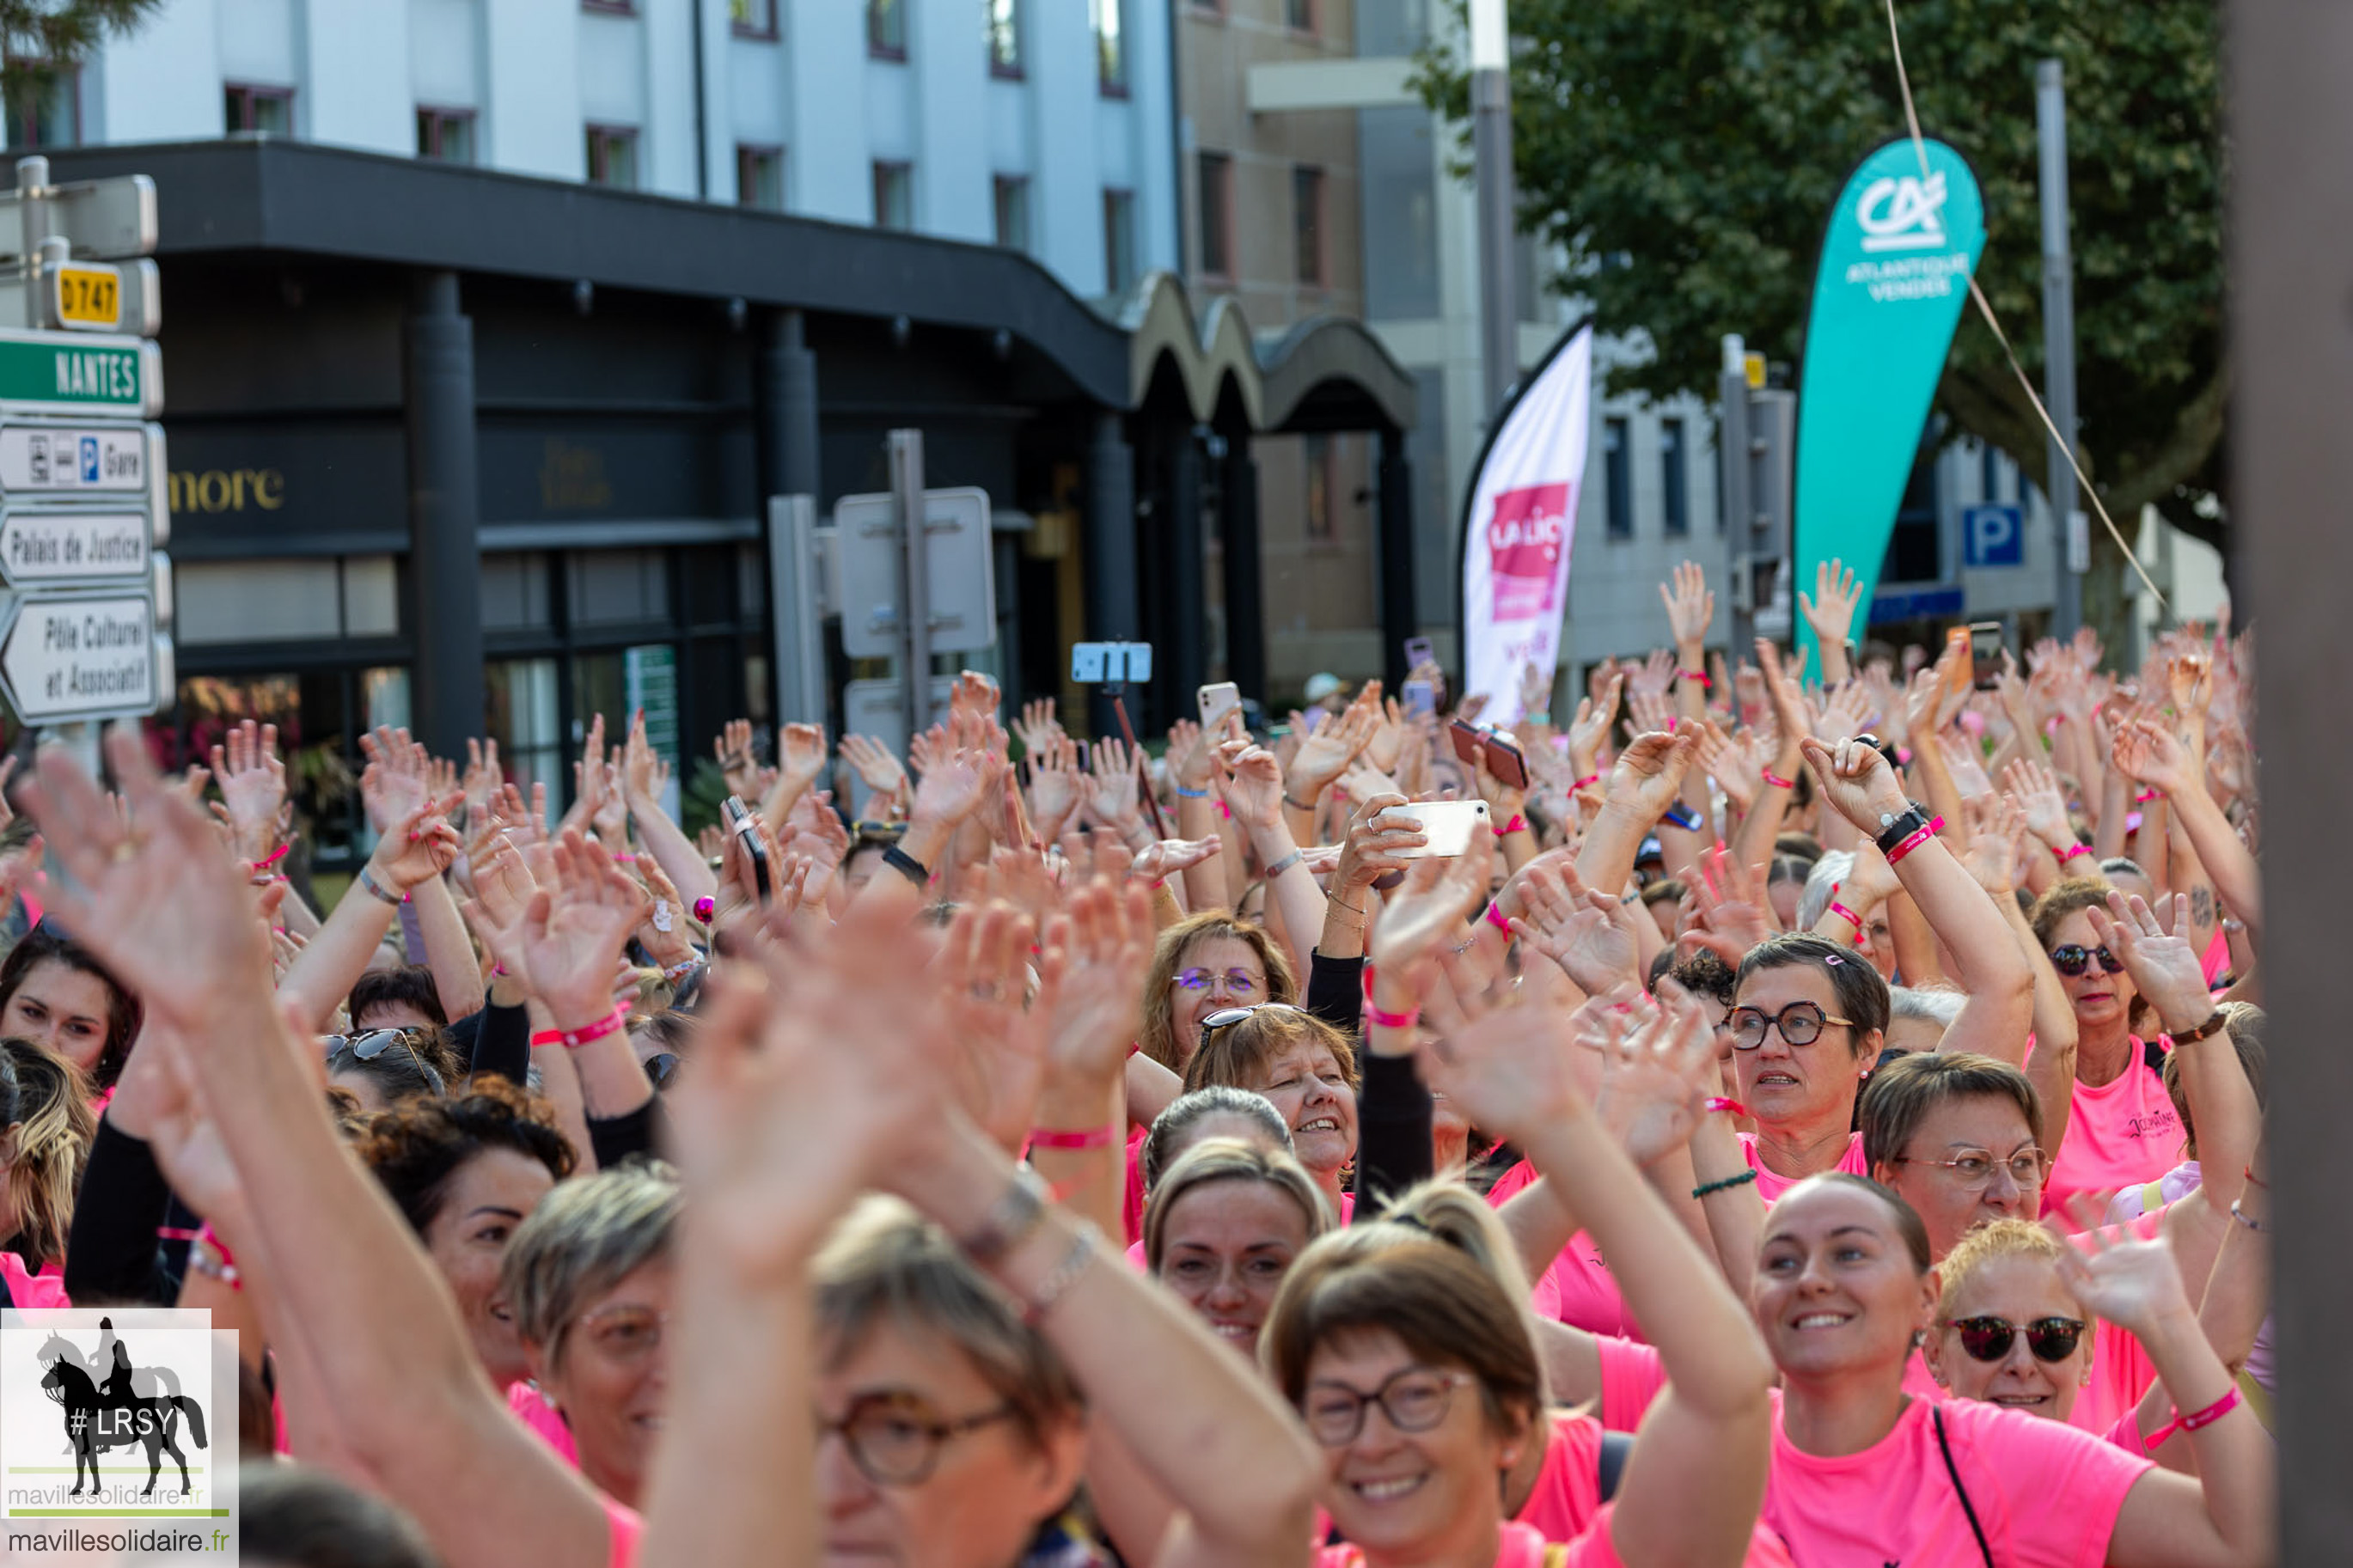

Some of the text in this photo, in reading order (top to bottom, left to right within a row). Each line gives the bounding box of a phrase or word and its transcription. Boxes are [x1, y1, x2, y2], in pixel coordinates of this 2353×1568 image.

[1846, 253, 1969, 284] ATLANTIQUE
[55, 351, 136, 398] NANTES
[104, 442, 138, 478] Gare
[11, 526, 139, 566] Palais de Justice
[44, 613, 144, 653] Pôle Culturel
[46, 659, 144, 700] et Associatif
